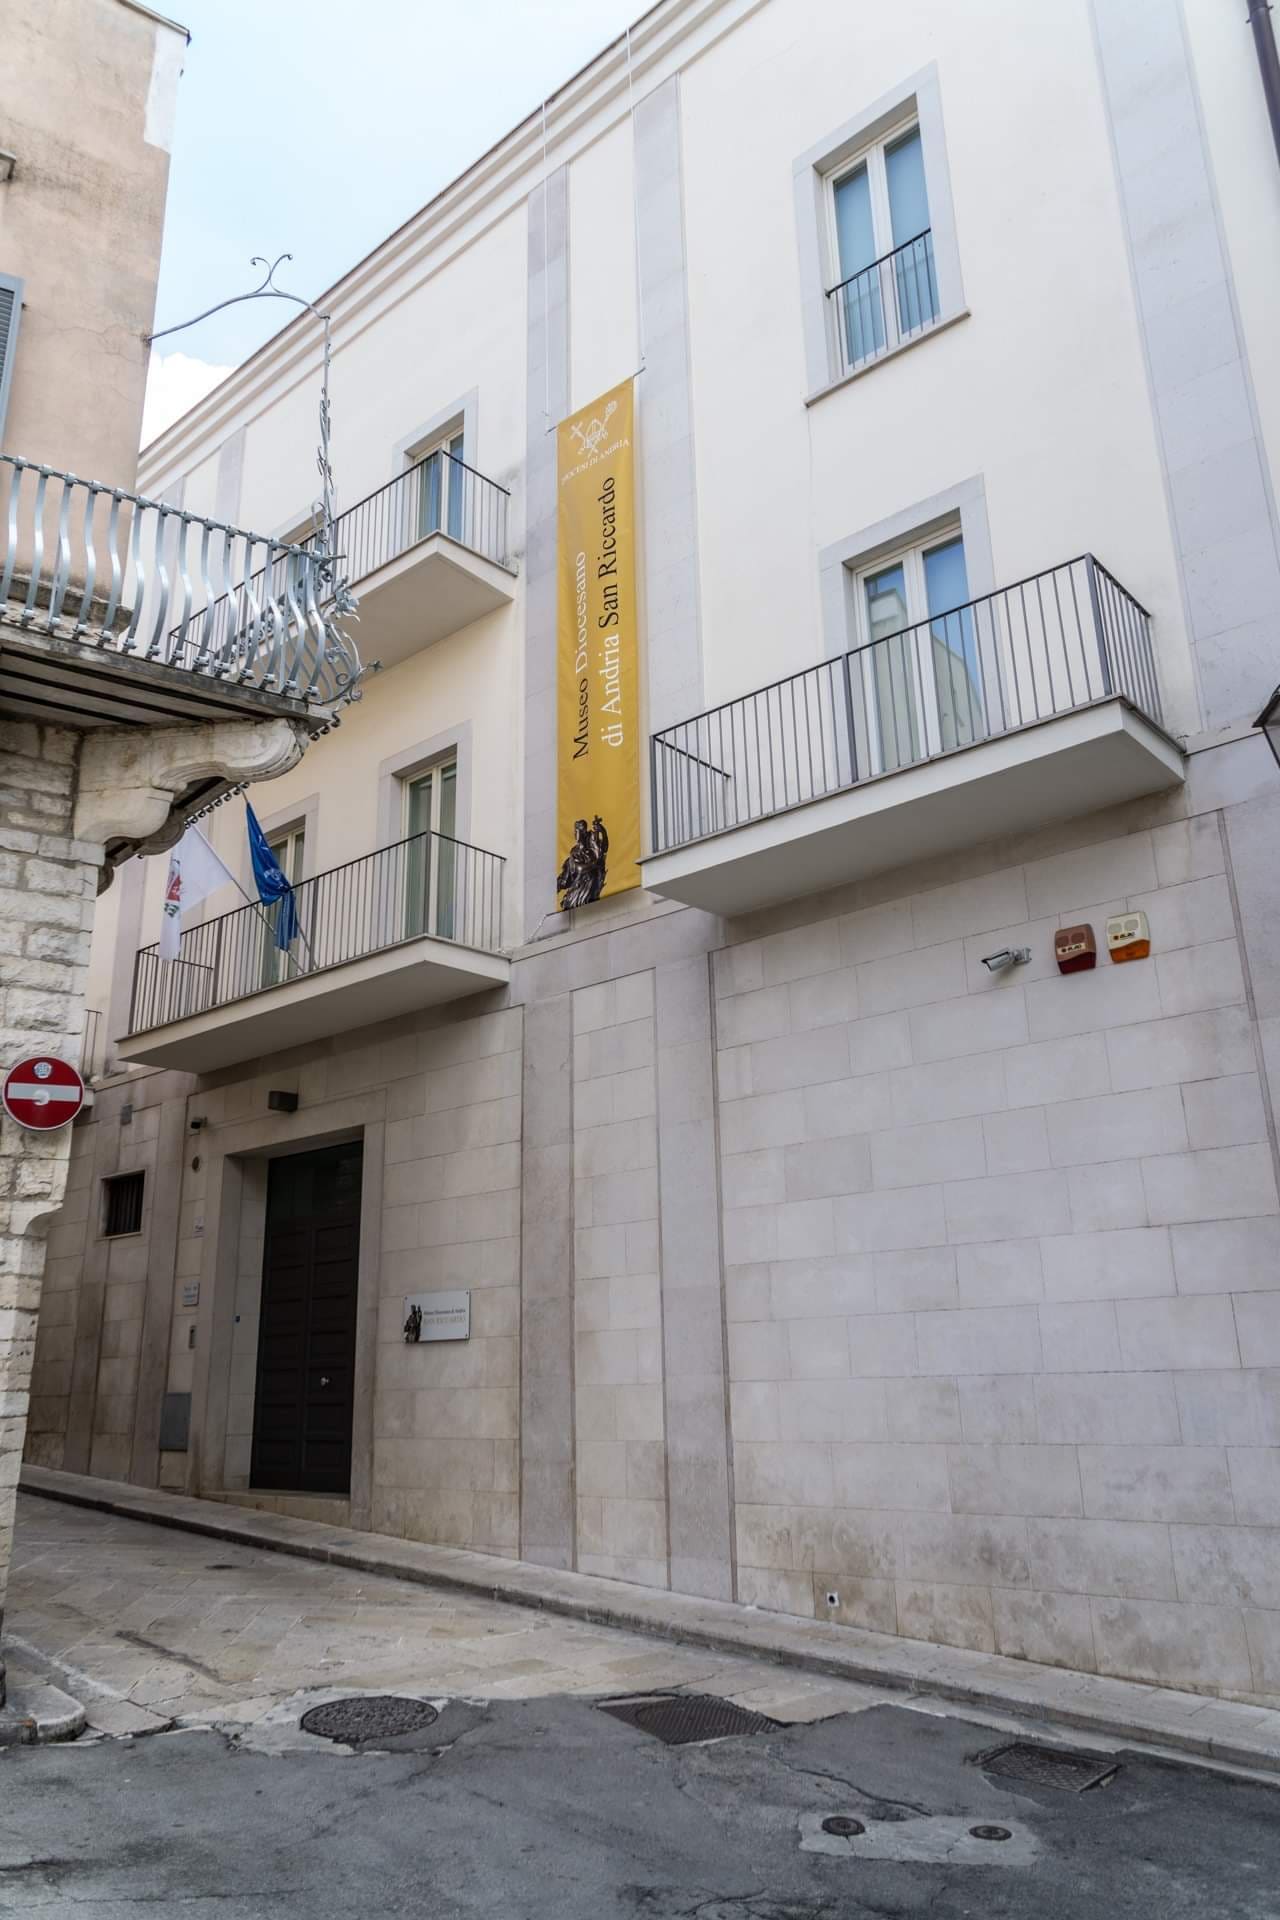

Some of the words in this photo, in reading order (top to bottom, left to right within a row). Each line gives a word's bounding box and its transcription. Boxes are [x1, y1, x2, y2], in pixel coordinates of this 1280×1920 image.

[597, 477, 617, 579] Riccardo
[575, 551, 588, 674] Diocesano
[598, 584, 619, 629] San
[598, 634, 622, 715] Andria
[573, 678, 589, 761] Museo
[601, 723, 624, 747] di
